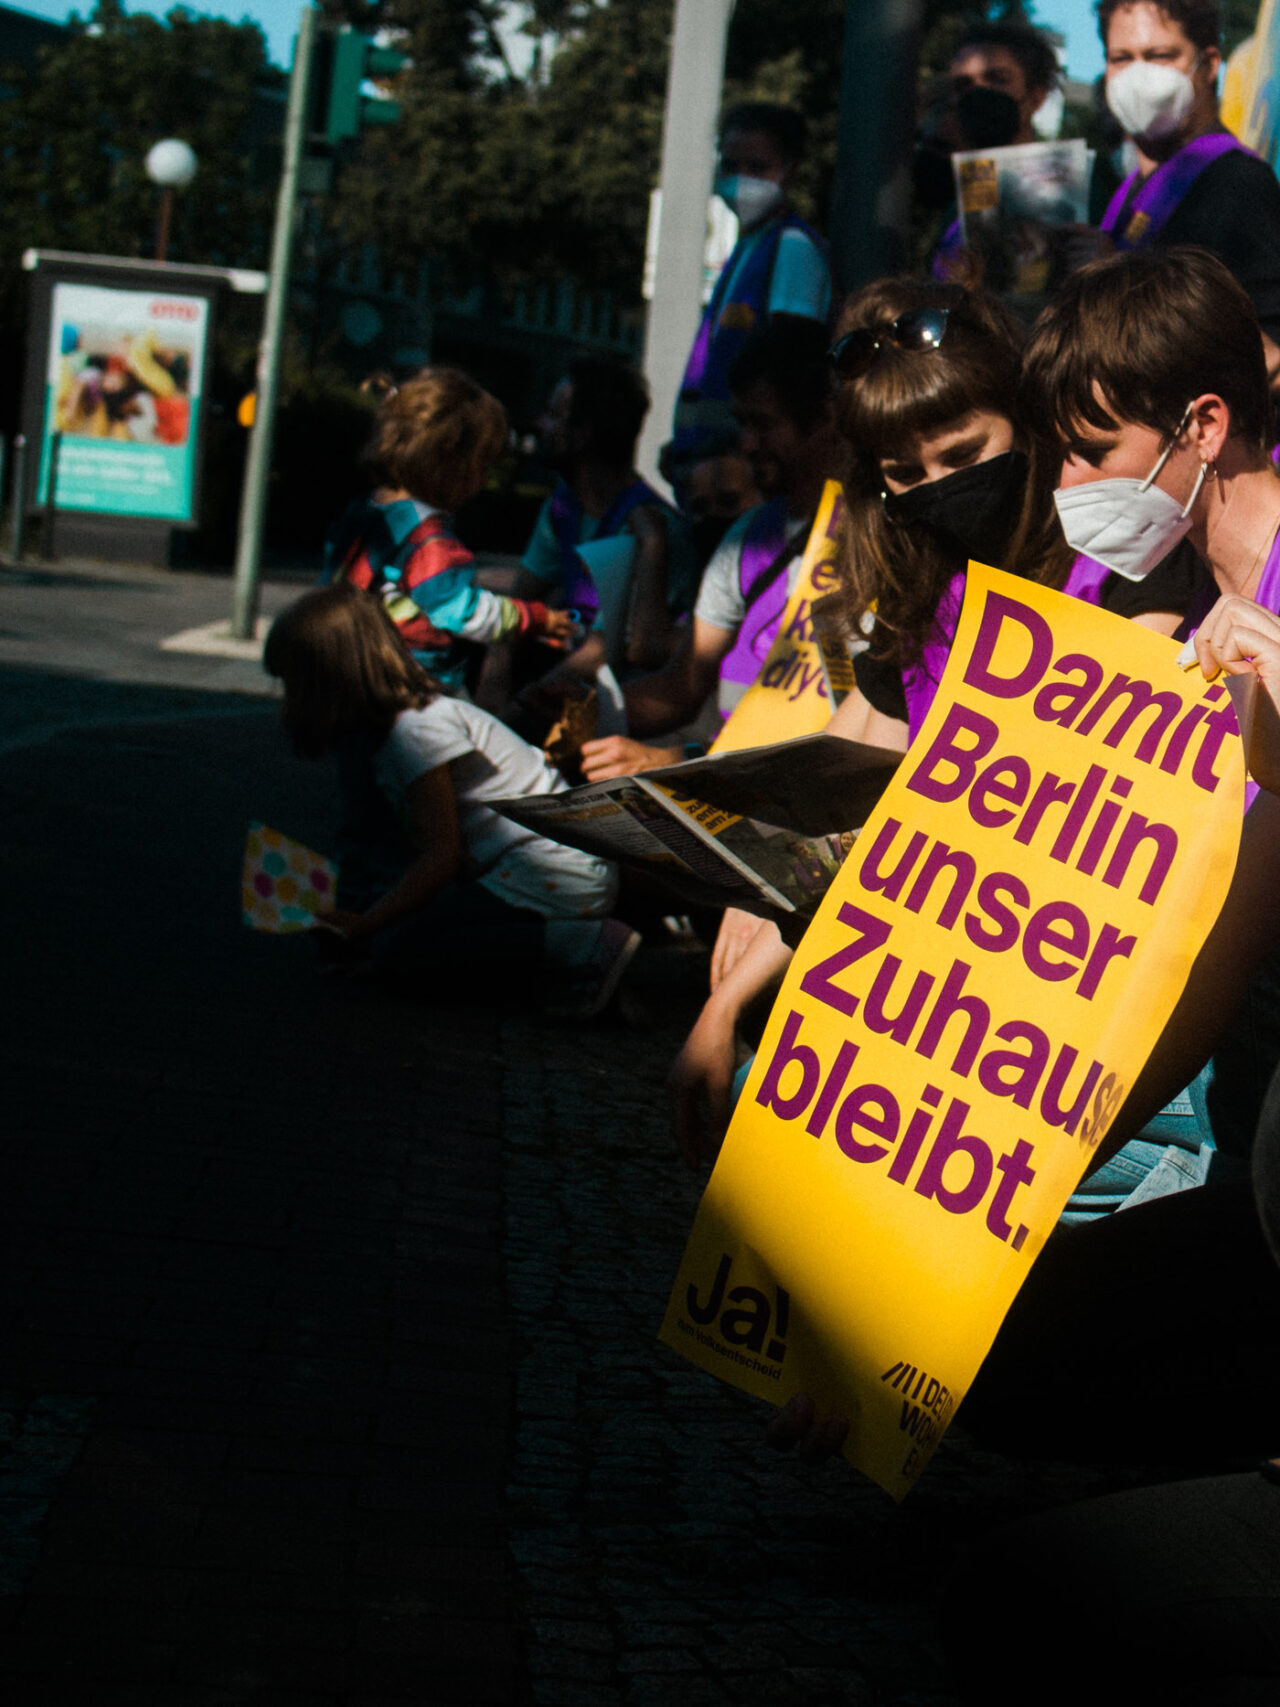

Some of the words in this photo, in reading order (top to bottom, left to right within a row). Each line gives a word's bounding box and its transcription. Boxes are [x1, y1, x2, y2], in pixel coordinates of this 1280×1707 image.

[963, 590, 1240, 793] Damit
[906, 702, 1178, 906] Berlin
[859, 817, 1138, 1001] unser
[800, 901, 1123, 1149] Zuhause
[755, 1010, 1036, 1253] bleibt.
[686, 1253, 790, 1363] Ja!
